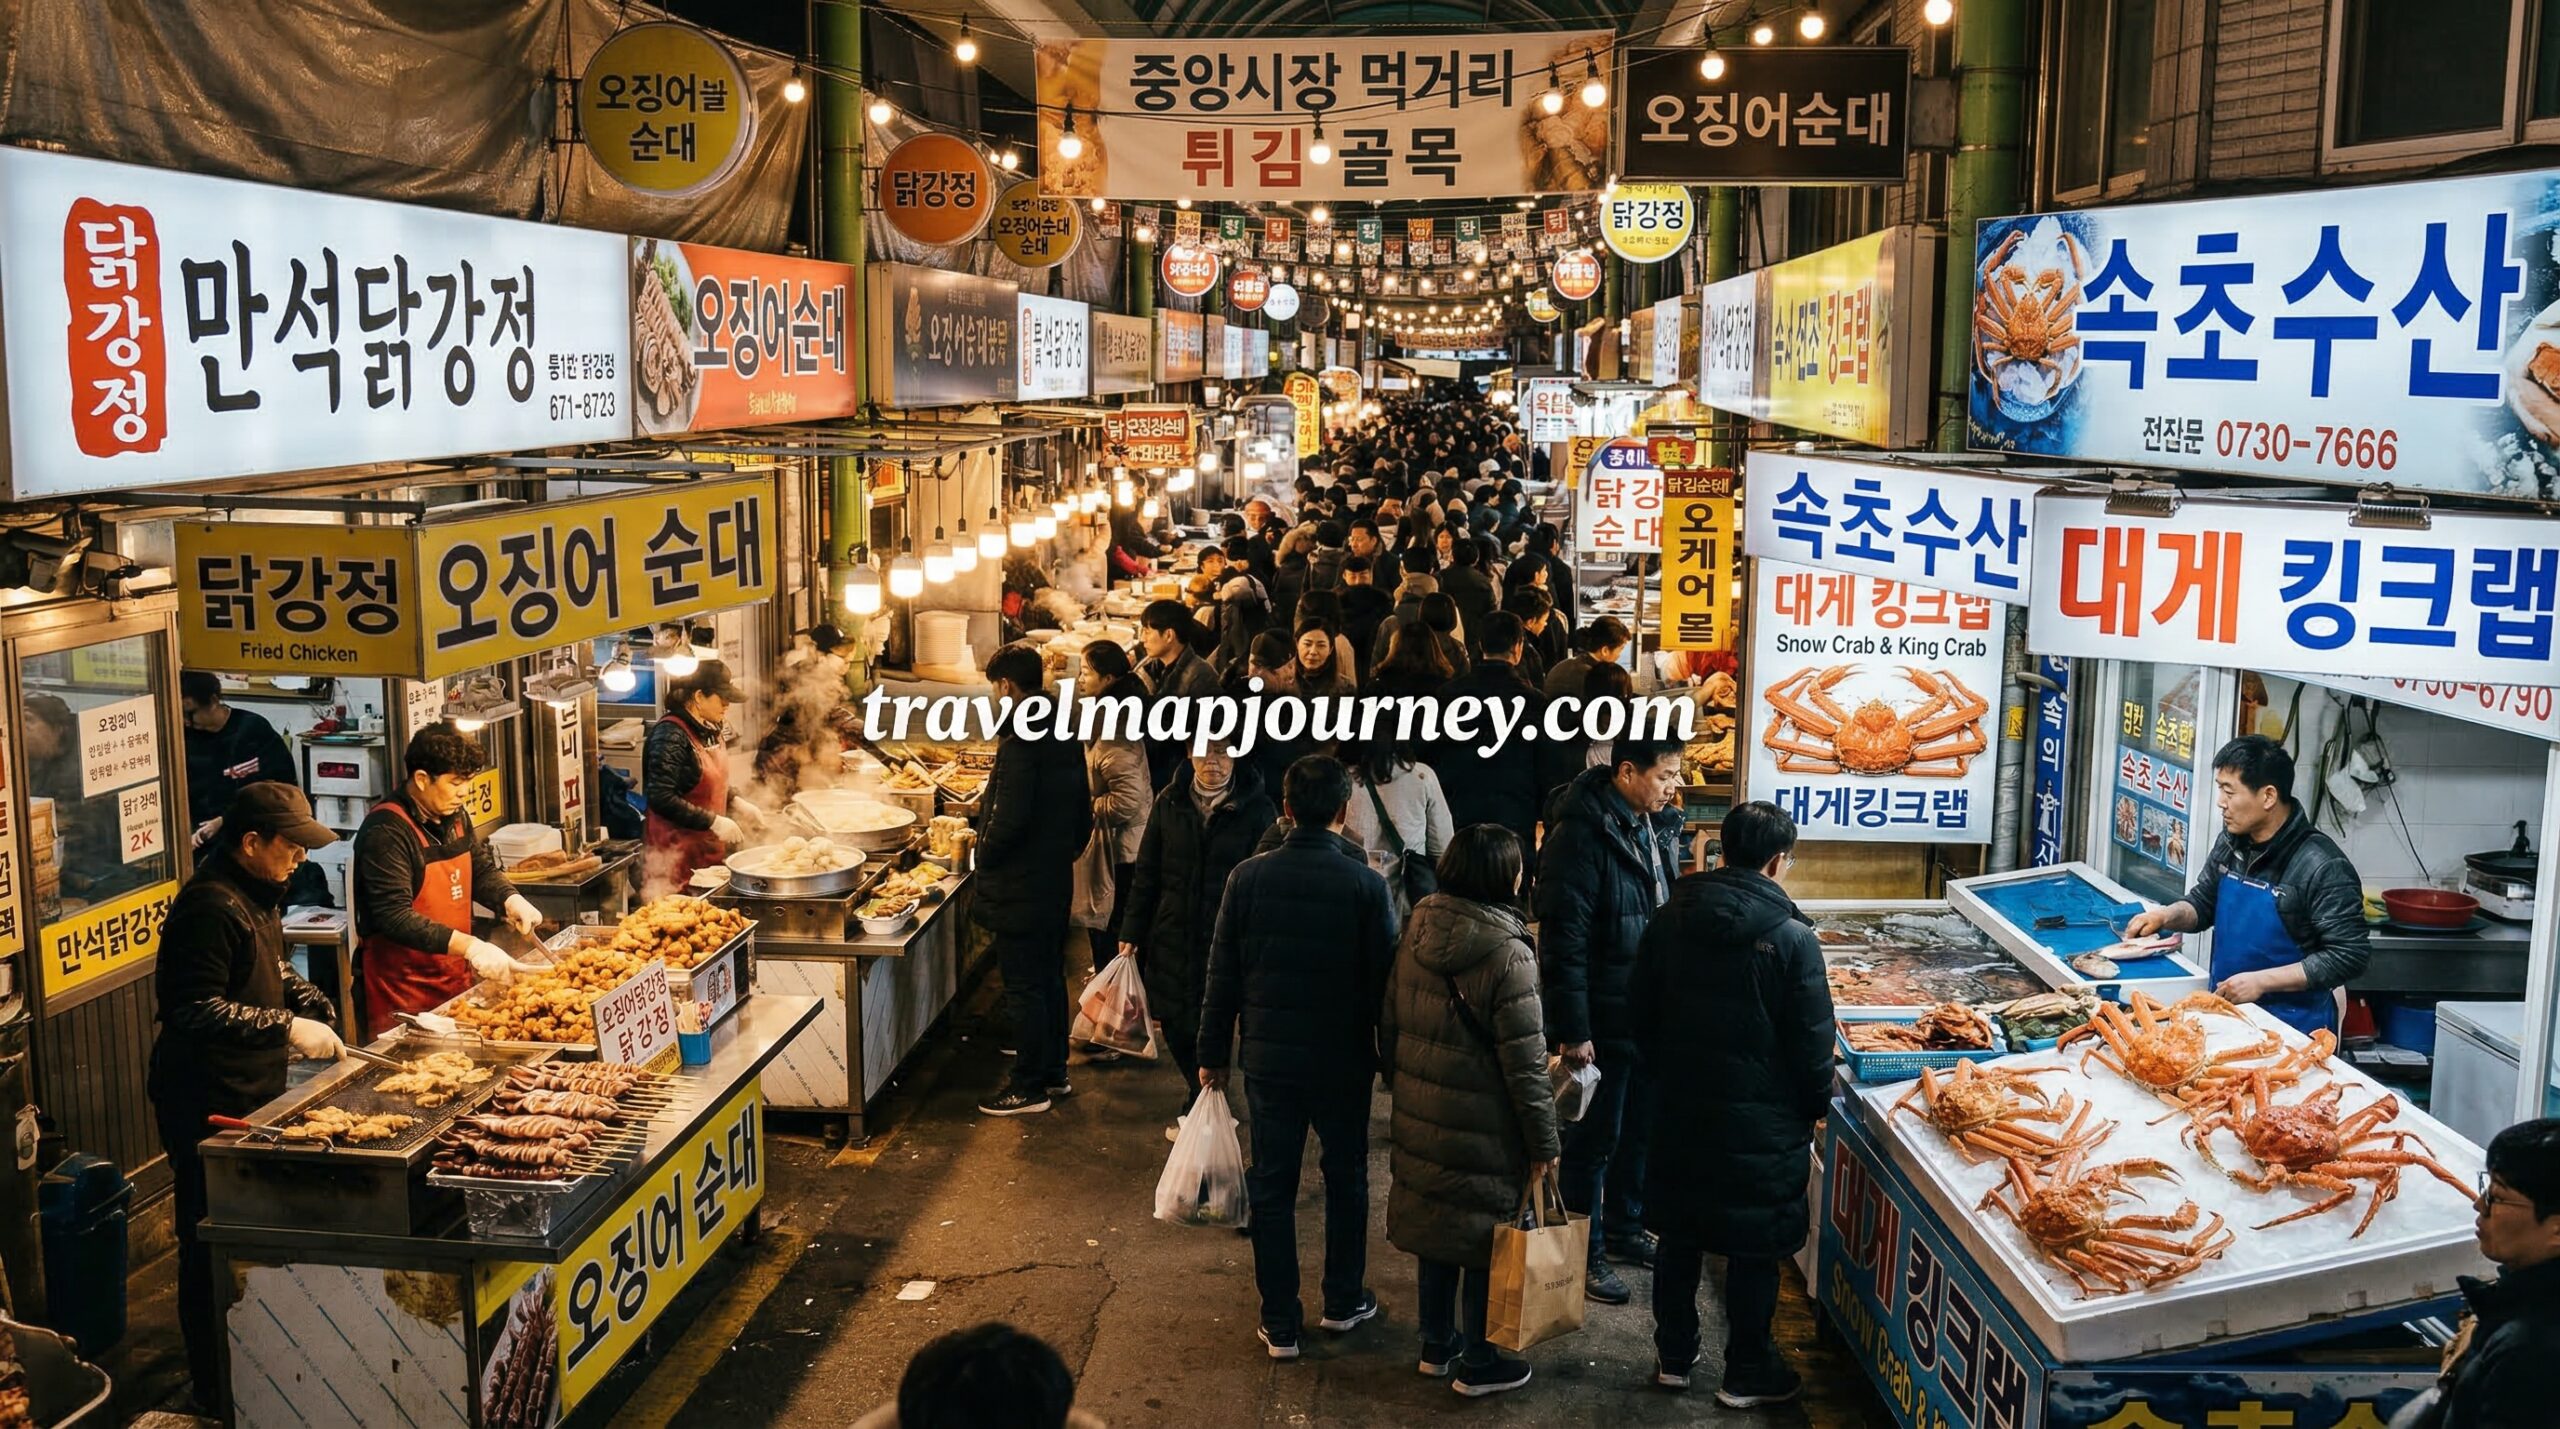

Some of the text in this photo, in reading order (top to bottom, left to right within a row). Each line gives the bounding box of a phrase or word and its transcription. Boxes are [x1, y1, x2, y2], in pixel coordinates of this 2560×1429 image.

[1130, 49, 1513, 112] 중앙시장 먹거리
[630, 121, 696, 162] 순대
[1641, 92, 1891, 147] 오징어순대
[1182, 127, 1462, 188] 튀김 골목
[893, 171, 977, 208] 닭강정
[1612, 200, 1684, 230] 닭강정
[1020, 237, 1048, 255] 순대
[79, 216, 151, 443] 닭강정
[180, 239, 536, 414] 만석닭강정
[693, 275, 846, 379] 오징어순대
[2076, 213, 2520, 399] 속초수산
[550, 392, 616, 421] 671-8723
[2217, 420, 2398, 470] 0730-7666
[1772, 471, 2027, 590] 속초수산
[198, 554, 399, 634] 닭강정
[437, 497, 763, 649] 오징어 순대
[1775, 573, 1991, 631] 대게 킹크랩
[2059, 526, 2560, 661] 대게 킹크랩
[241, 643, 358, 662] Fried Chicken
[1776, 633, 1987, 660] Snow Crab & King Crab
[1775, 786, 1969, 829] 대게킹크랩
[130, 829, 153, 852] 2K
[57, 895, 173, 976] 만석닭강정
[602, 967, 667, 1034] 오징어닭강정
[618, 1000, 670, 1063] 닭강정
[566, 1172, 686, 1374] 오징어
[692, 1099, 758, 1243] 순대
[1831, 1135, 2029, 1429] 대게 킹크랩
[1832, 1263, 1876, 1349] Snow
[1877, 1324, 1914, 1417] Crab
